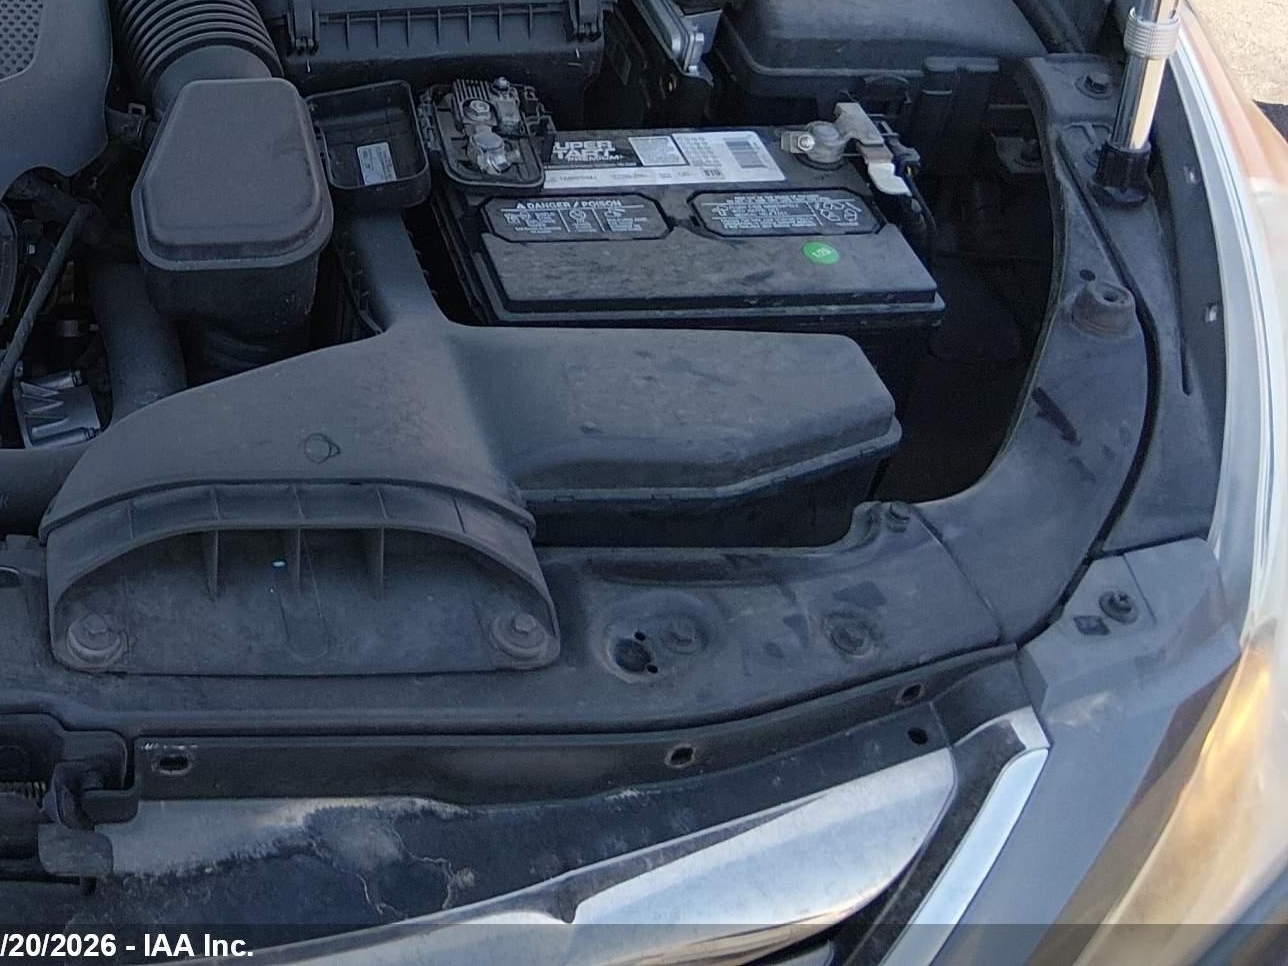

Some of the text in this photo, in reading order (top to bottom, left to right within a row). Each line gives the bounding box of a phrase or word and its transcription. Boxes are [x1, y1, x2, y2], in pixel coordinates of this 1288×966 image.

[553, 140, 612, 152] UPER
[552, 146, 616, 159] TART
[527, 201, 571, 210] DANGER
[581, 199, 623, 209] POISON
